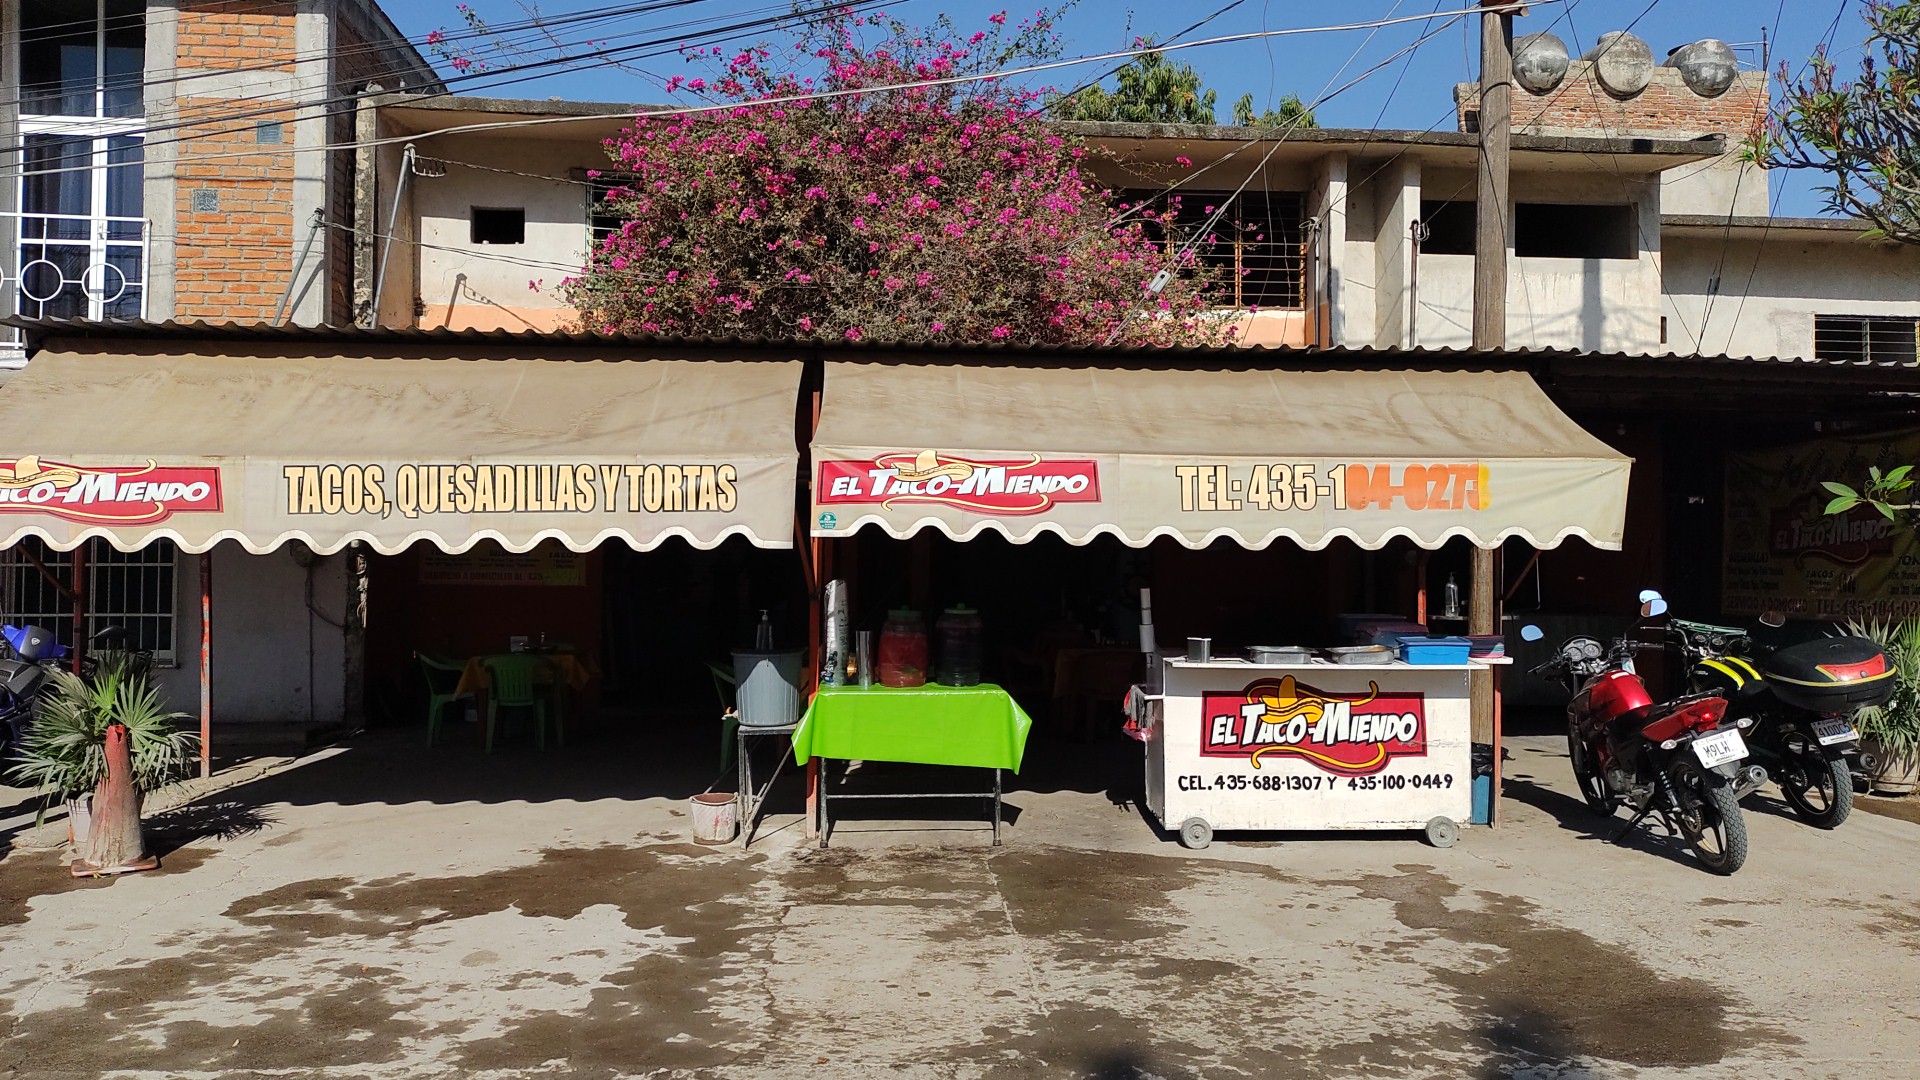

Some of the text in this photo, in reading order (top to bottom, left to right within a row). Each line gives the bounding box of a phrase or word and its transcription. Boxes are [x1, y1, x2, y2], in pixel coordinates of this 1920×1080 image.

[283, 463, 739, 520] TACOS, QUESADILLAS Y TORTAS
[830, 476, 863, 497] EL
[1210, 715, 1238, 746] EL
[1327, 776, 1338, 790] Y
